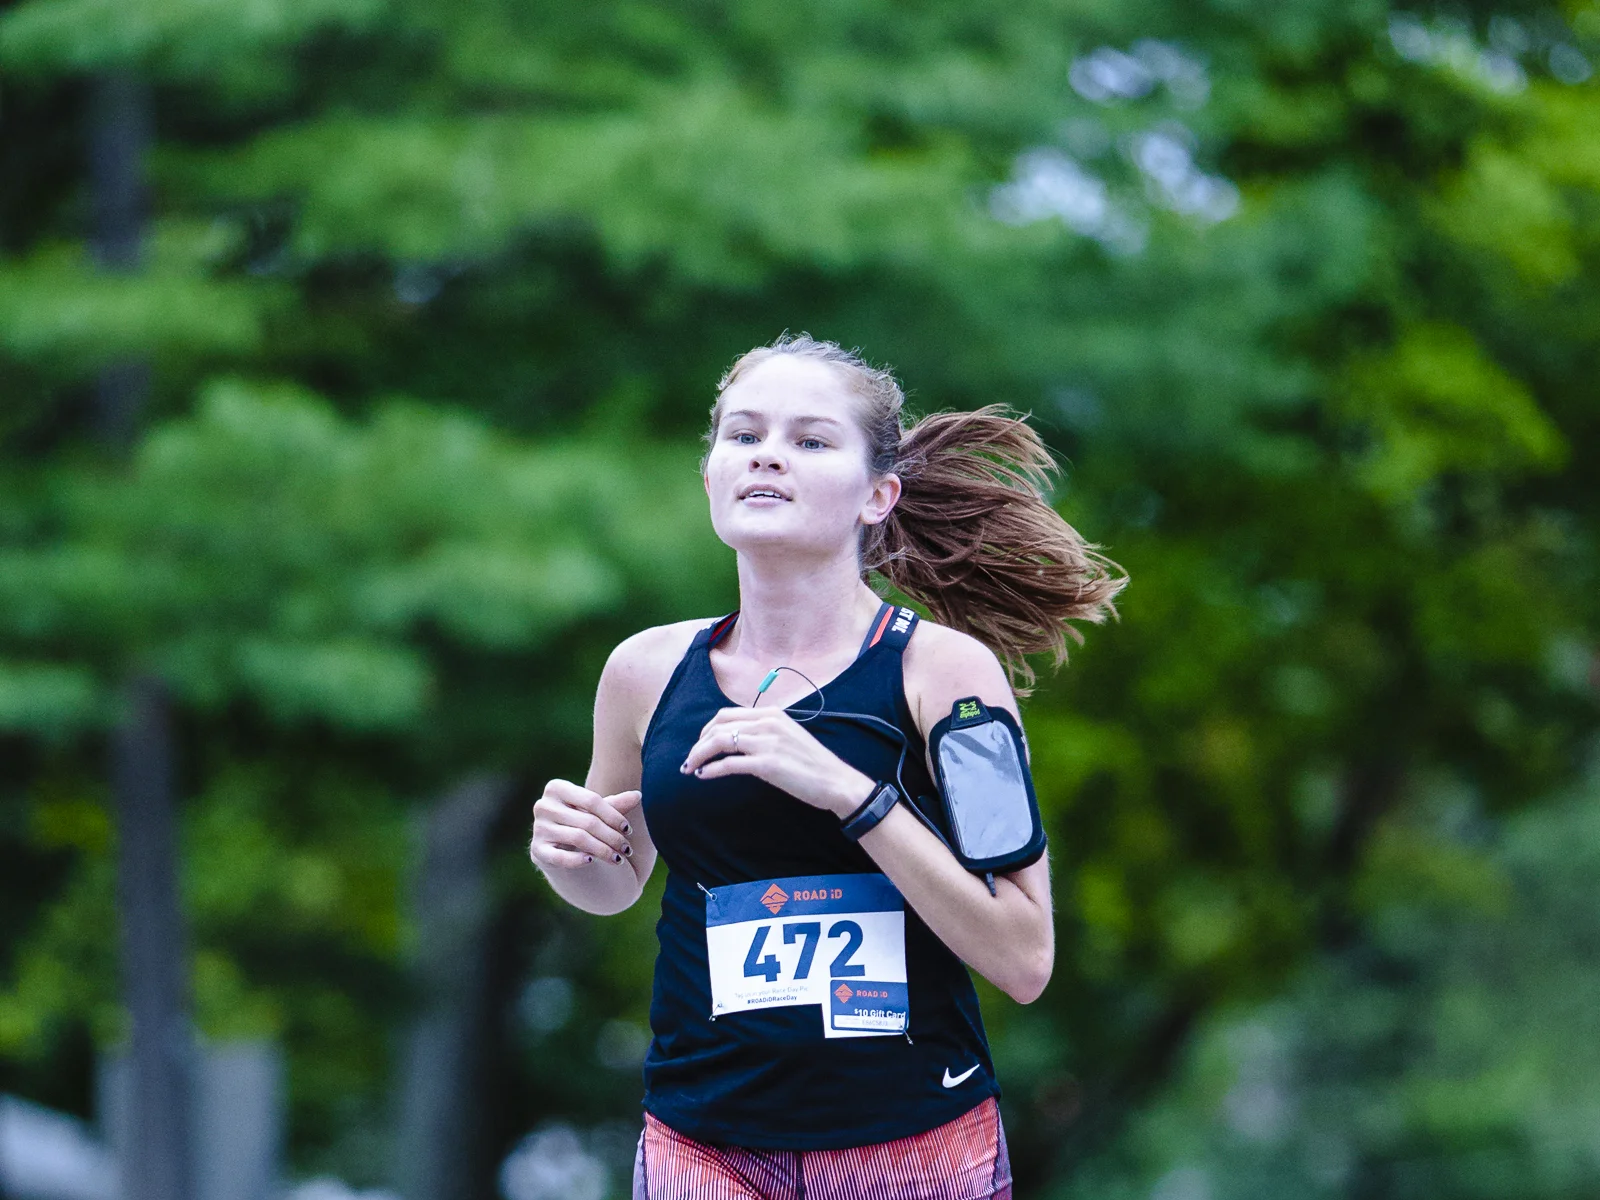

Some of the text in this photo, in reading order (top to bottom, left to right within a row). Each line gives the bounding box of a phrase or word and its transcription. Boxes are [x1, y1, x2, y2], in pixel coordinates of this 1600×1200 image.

[793, 889, 827, 901] ROAD
[743, 920, 865, 982] 472
[856, 990, 879, 998] ROAD
[854, 1008, 906, 1019] $10 Gift Card
